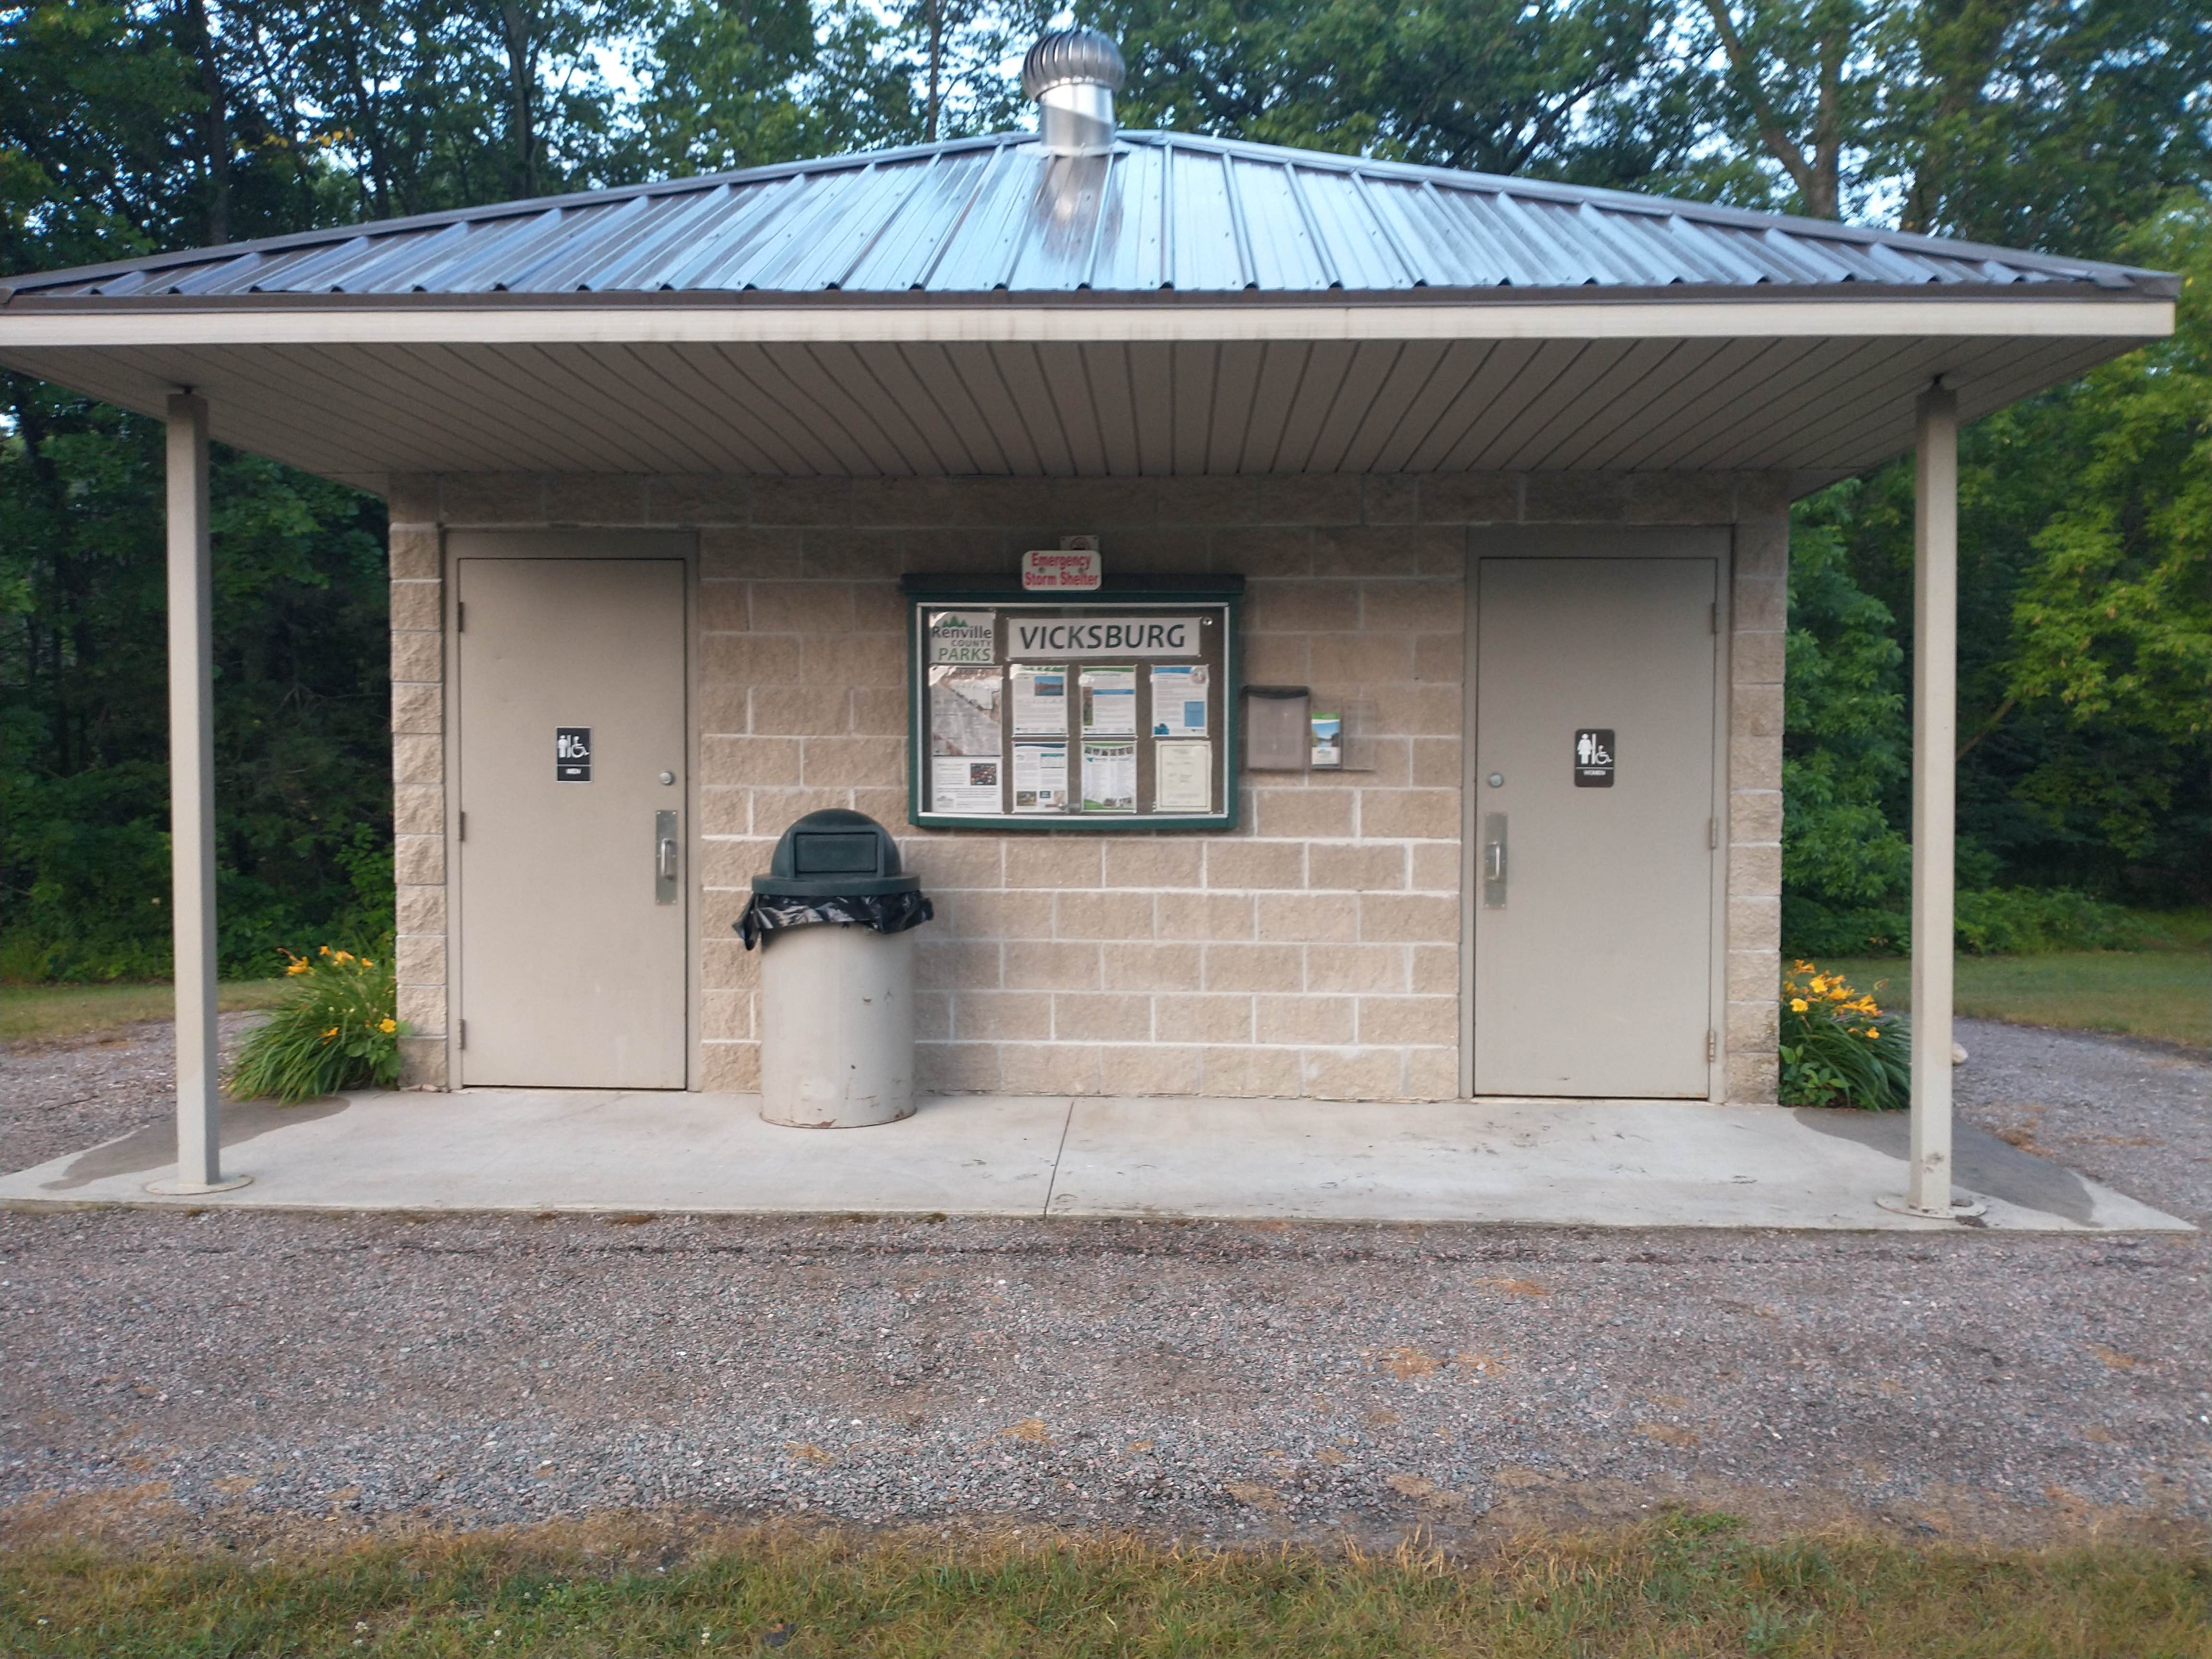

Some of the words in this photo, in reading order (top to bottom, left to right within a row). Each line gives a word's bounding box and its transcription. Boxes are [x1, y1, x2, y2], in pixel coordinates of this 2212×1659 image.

[1032, 553, 1091, 570] Emergency
[1025, 571, 1057, 586] Storm
[1060, 571, 1099, 585] Shelter
[933, 625, 992, 638] Renville
[1020, 624, 1185, 649] VICKSBURG
[938, 648, 991, 661] PARKS
